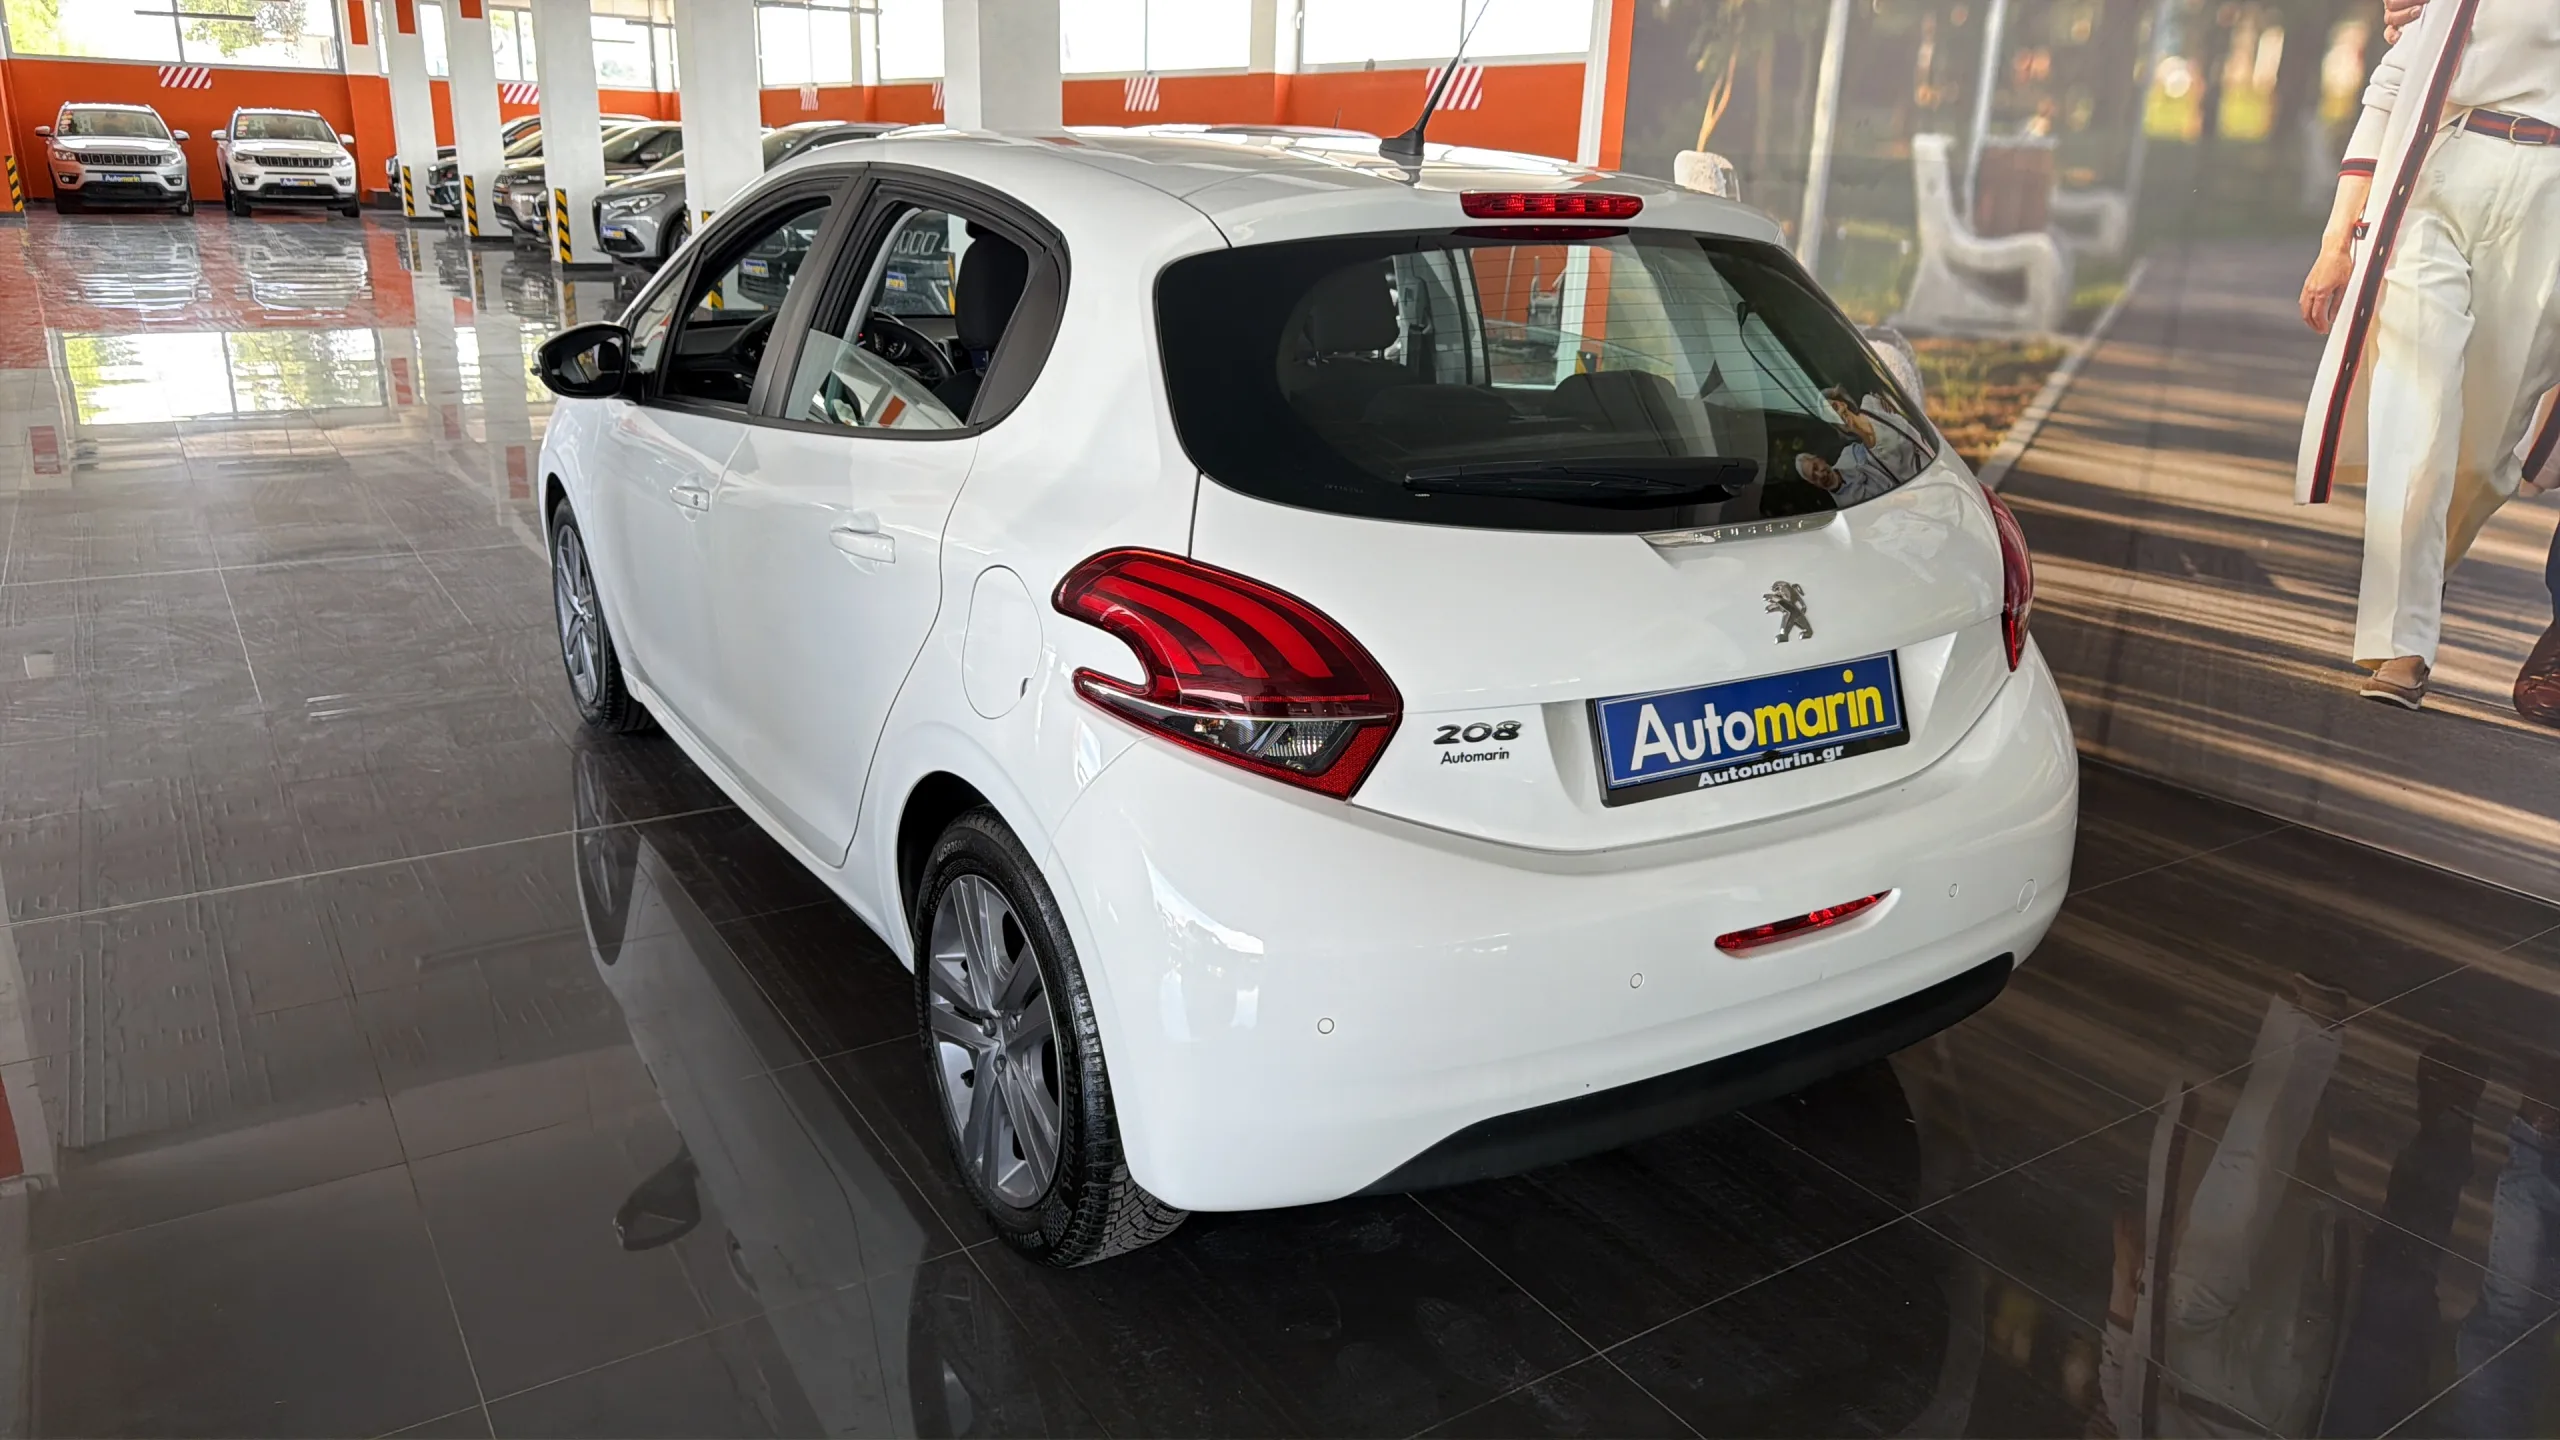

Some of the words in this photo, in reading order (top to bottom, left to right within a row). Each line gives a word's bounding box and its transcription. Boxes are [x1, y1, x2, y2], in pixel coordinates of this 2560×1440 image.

[1432, 720, 1522, 745] 208
[1630, 669, 1885, 771] Automarin
[1440, 746, 1510, 765] Automarin
[1697, 744, 1845, 788] Automarin.gr
